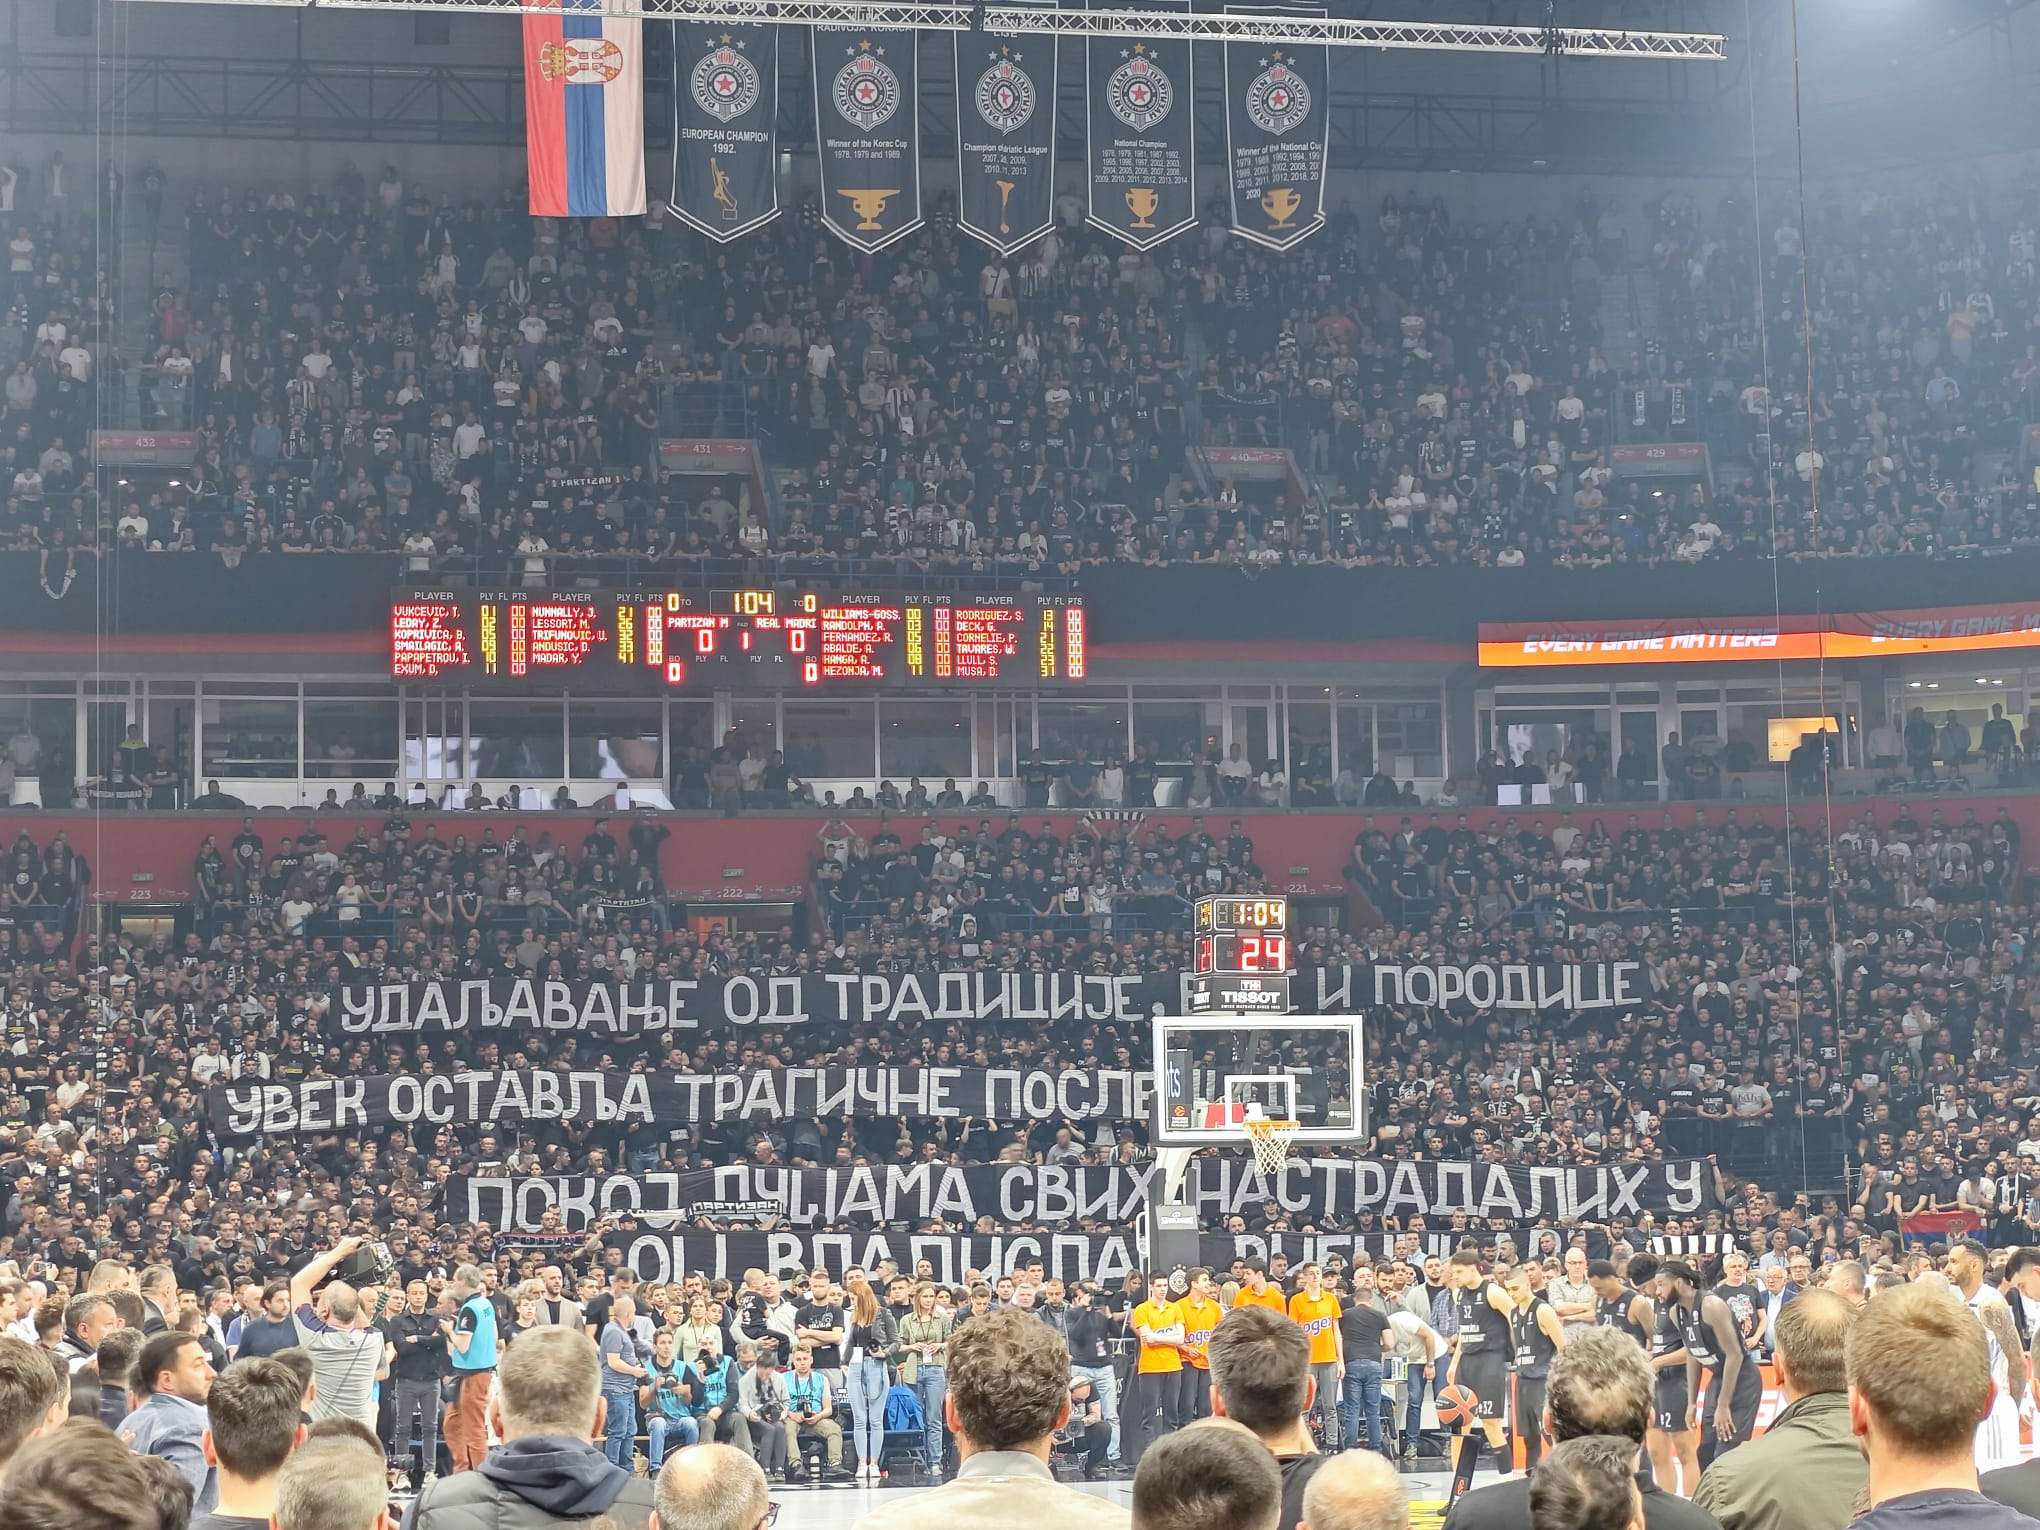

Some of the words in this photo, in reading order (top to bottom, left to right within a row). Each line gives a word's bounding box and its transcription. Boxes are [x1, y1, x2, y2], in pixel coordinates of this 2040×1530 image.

[682, 128, 725, 140] EUROPEAN
[726, 130, 769, 142] CHAMPION
[712, 143, 737, 154] 1992.
[827, 139, 851, 148] Winner
[852, 139, 860, 148] of
[860, 139, 872, 148] the
[873, 139, 894, 148] Korac
[894, 139, 908, 149] Cup
[963, 143, 997, 153] Champion
[1024, 145, 1048, 156] League
[1114, 140, 1138, 148] National
[1138, 140, 1167, 150] Champion
[1237, 148, 1260, 157] Winner
[1261, 145, 1268, 154] of
[1269, 143, 1279, 152] the
[1280, 142, 1308, 151] National
[135, 438, 156, 447] 432
[693, 444, 711, 454] 431
[1646, 448, 1666, 458] 429
[415, 592, 453, 600] PLAYER
[552, 593, 591, 601] PLAYER
[843, 596, 880, 604] PLAYER
[905, 596, 918, 604] PLY
[923, 596, 933, 604] FL
[936, 596, 951, 604] PTS
[975, 596, 1013, 605] PLAYER
[1038, 597, 1050, 605] PLY
[1055, 597, 1064, 606] FL
[1068, 598, 1082, 606] PTS
[668, 593, 679, 611] 0
[804, 595, 816, 612] 0
[394, 606, 449, 617] VUKCEVIC,
[481, 605, 497, 617] 01
[906, 608, 921, 620] 00
[957, 610, 1012, 621] RODRIGUEZ,
[394, 618, 429, 629] LEDAY,
[482, 617, 497, 628] 02
[532, 619, 577, 629] LESSORT,
[668, 617, 715, 628] PARTIZAN
[719, 617, 729, 628] M
[756, 618, 781, 628] REAL
[785, 618, 817, 629] MADRI
[823, 621, 874, 631] RANDOLPH,
[907, 620, 921, 631] 03
[957, 622, 984, 632] DECK,
[394, 630, 453, 640] KOPRIVICA,
[482, 629, 497, 640] 05
[1872, 618, 1946, 643] EVERY
[1952, 615, 2016, 638] GAME
[532, 630, 595, 641] TRIFUNOVIC,
[699, 629, 713, 652] 0
[791, 629, 805, 652] 0
[823, 632, 881, 642] FERNANDEZ,
[907, 631, 922, 642] 05
[957, 633, 1006, 643] CORNELIE,
[1523, 633, 1598, 653] EVERY
[1600, 630, 1666, 651] GAME
[1671, 628, 1778, 649] MATTERS
[394, 641, 452, 651] SMAILAGIC,
[482, 640, 497, 651] 09
[532, 642, 579, 652] ANDUSIC,
[823, 643, 862, 653] ABALDE,
[908, 642, 922, 653] 06
[957, 644, 1002, 654] TAVARES,
[394, 653, 459, 663] PAPAPETROU,
[486, 652, 497, 663] 10
[532, 653, 569, 663] MADAR,
[823, 655, 858, 665] HANGA,
[908, 654, 922, 665] 08
[957, 656, 986, 665] LLULL,
[394, 664, 426, 674] EXUM,
[486, 663, 497, 674] 11
[824, 666, 870, 676] HEZONJA,
[912, 665, 923, 676] 11
[957, 667, 986, 677] MUSA,
[723, 888, 743, 898] 222
[1289, 884, 1308, 893] 221
[130, 890, 151, 899] 223
[1239, 902, 1282, 926] 1:04
[341, 978, 699, 1033] УДАЉАВАЊЕ
[723, 975, 809, 1025] ОД
[1317, 965, 1351, 1010] И
[1374, 961, 1642, 1010] ПОРОДИЦЕ
[1221, 991, 1280, 1004] TISSOT
[225, 1079, 368, 1135] УВЕК
[388, 1071, 655, 1124] ОСТАВЉА
[674, 1067, 961, 1122] ТРАГИЧНЕ
[1001, 1162, 1157, 1222] СВИХ
[1191, 1156, 1649, 1220] НАСТРАДАЛИХ
[1666, 1160, 1702, 1213] У
[692, 1201, 778, 1211] ПАРТИЗАН
